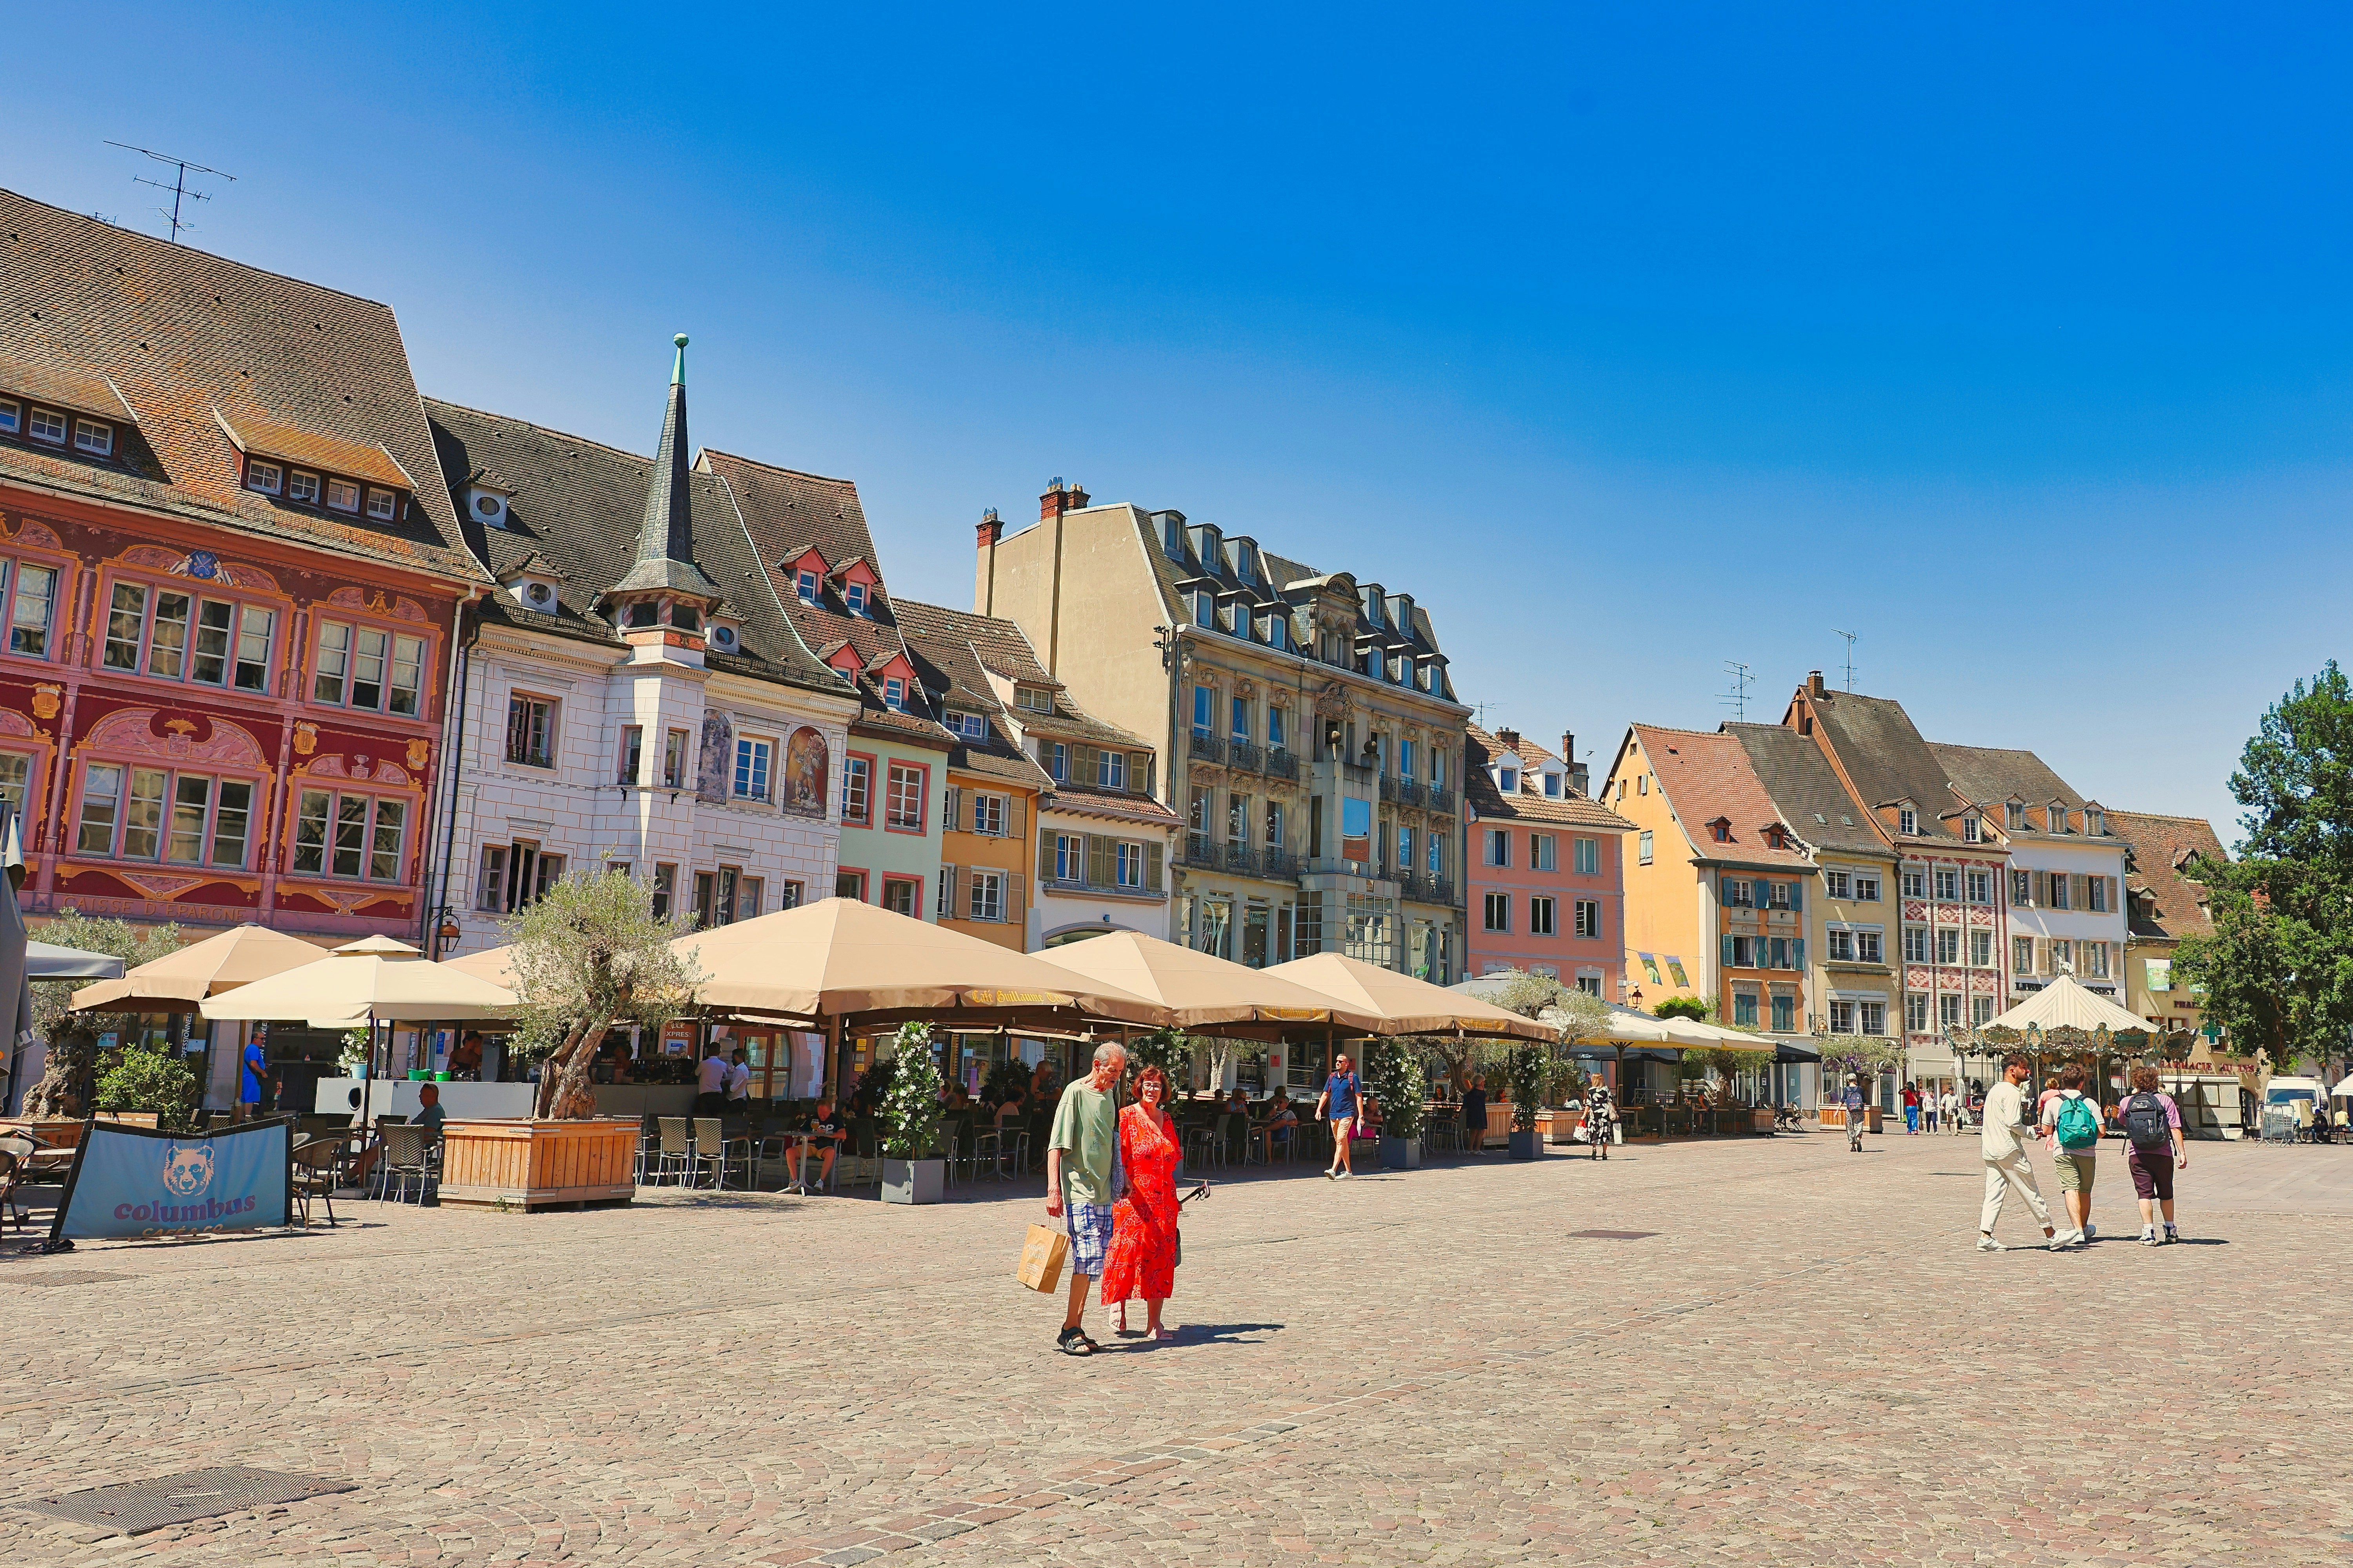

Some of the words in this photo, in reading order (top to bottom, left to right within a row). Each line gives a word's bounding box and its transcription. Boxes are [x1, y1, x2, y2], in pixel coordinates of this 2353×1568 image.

[63, 895, 134, 914] CAISSE
[972, 989, 993, 1003] Café
[996, 990, 1044, 1003] Guillaume
[1044, 992, 1067, 1003] Tell
[114, 1195, 256, 1223] columbus
[142, 1225, 186, 1236] CAFÉ
